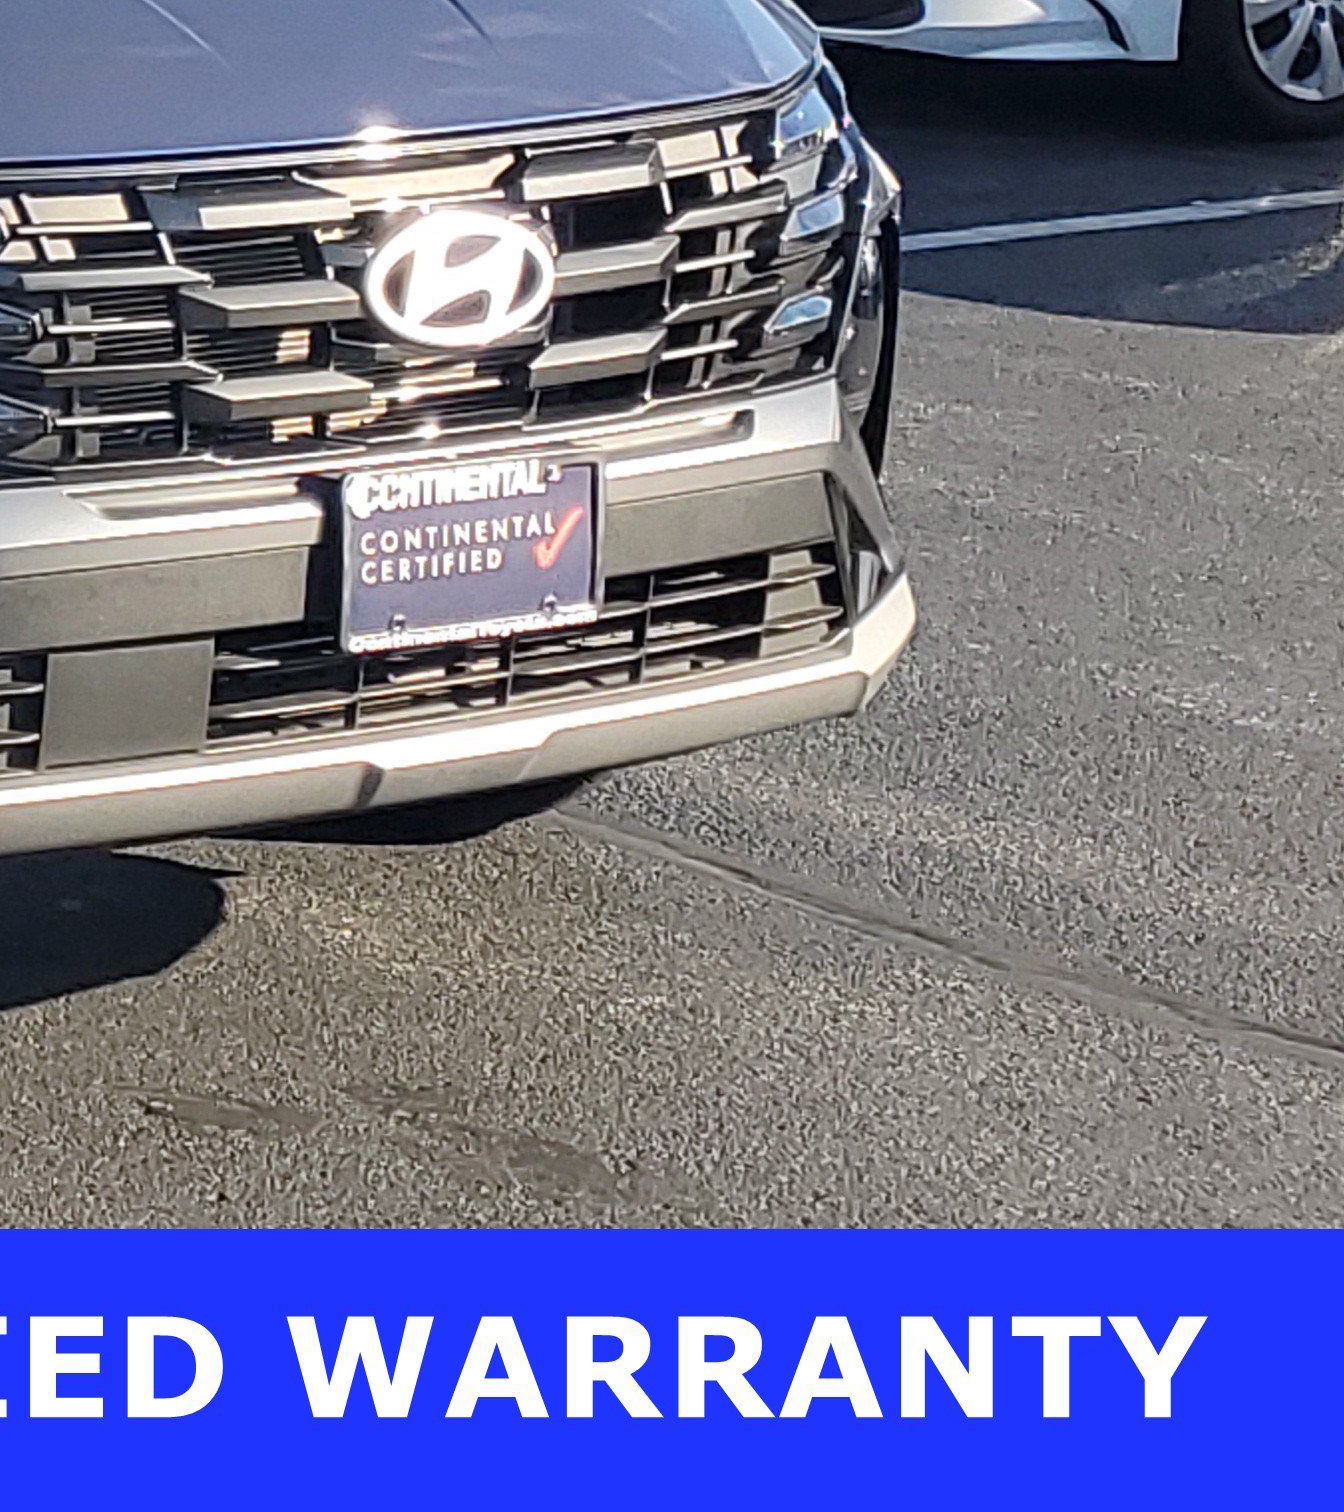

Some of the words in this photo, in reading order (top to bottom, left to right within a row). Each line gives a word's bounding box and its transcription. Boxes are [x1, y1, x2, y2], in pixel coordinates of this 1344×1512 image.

[346, 459, 546, 519] CONTINENTAL
[360, 511, 556, 555] CONTINENTAL
[361, 548, 503, 585] CERTIFIED
